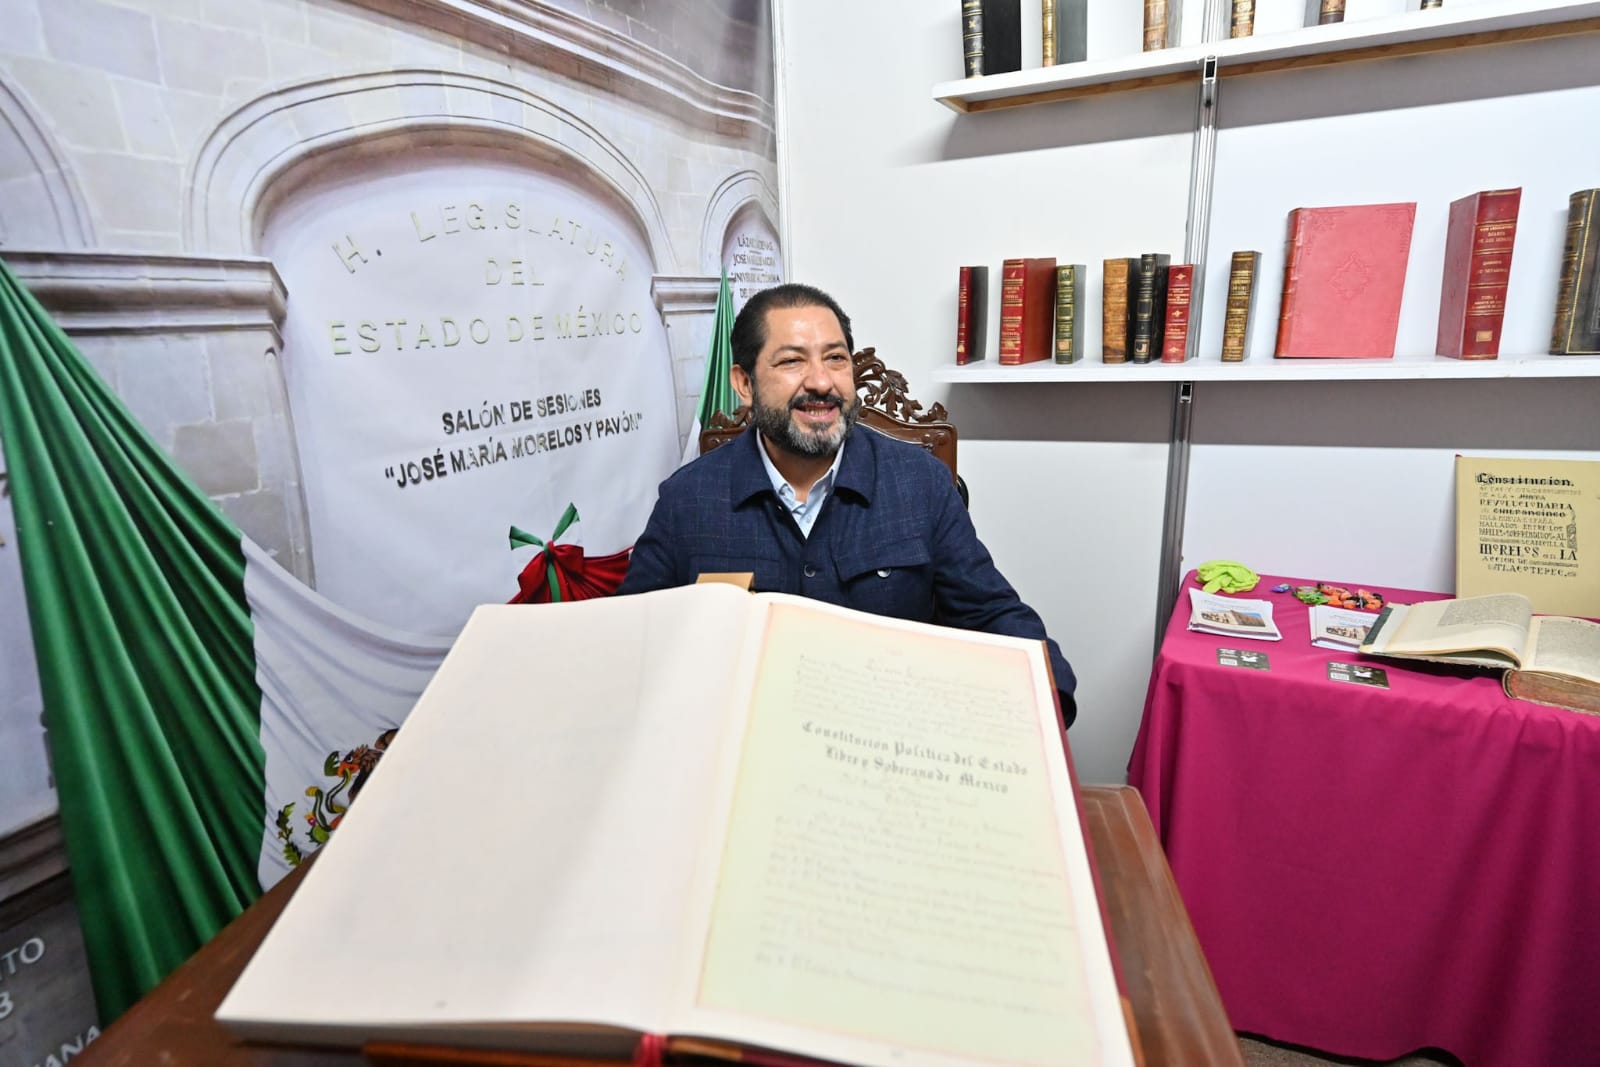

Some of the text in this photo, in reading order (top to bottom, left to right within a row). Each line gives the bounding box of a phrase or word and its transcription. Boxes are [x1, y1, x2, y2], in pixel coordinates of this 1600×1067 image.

[410, 202, 628, 281] LEGSATURA
[484, 259, 545, 286] DEL
[328, 305, 643, 355] ESTADO DE MÉXICO
[442, 388, 602, 435] SALÓN DE SESIONES
[450, 437, 508, 473] MARÍA
[512, 423, 583, 459] MORELOS
[584, 422, 593, 441] Y
[0, 938, 45, 980] TO
